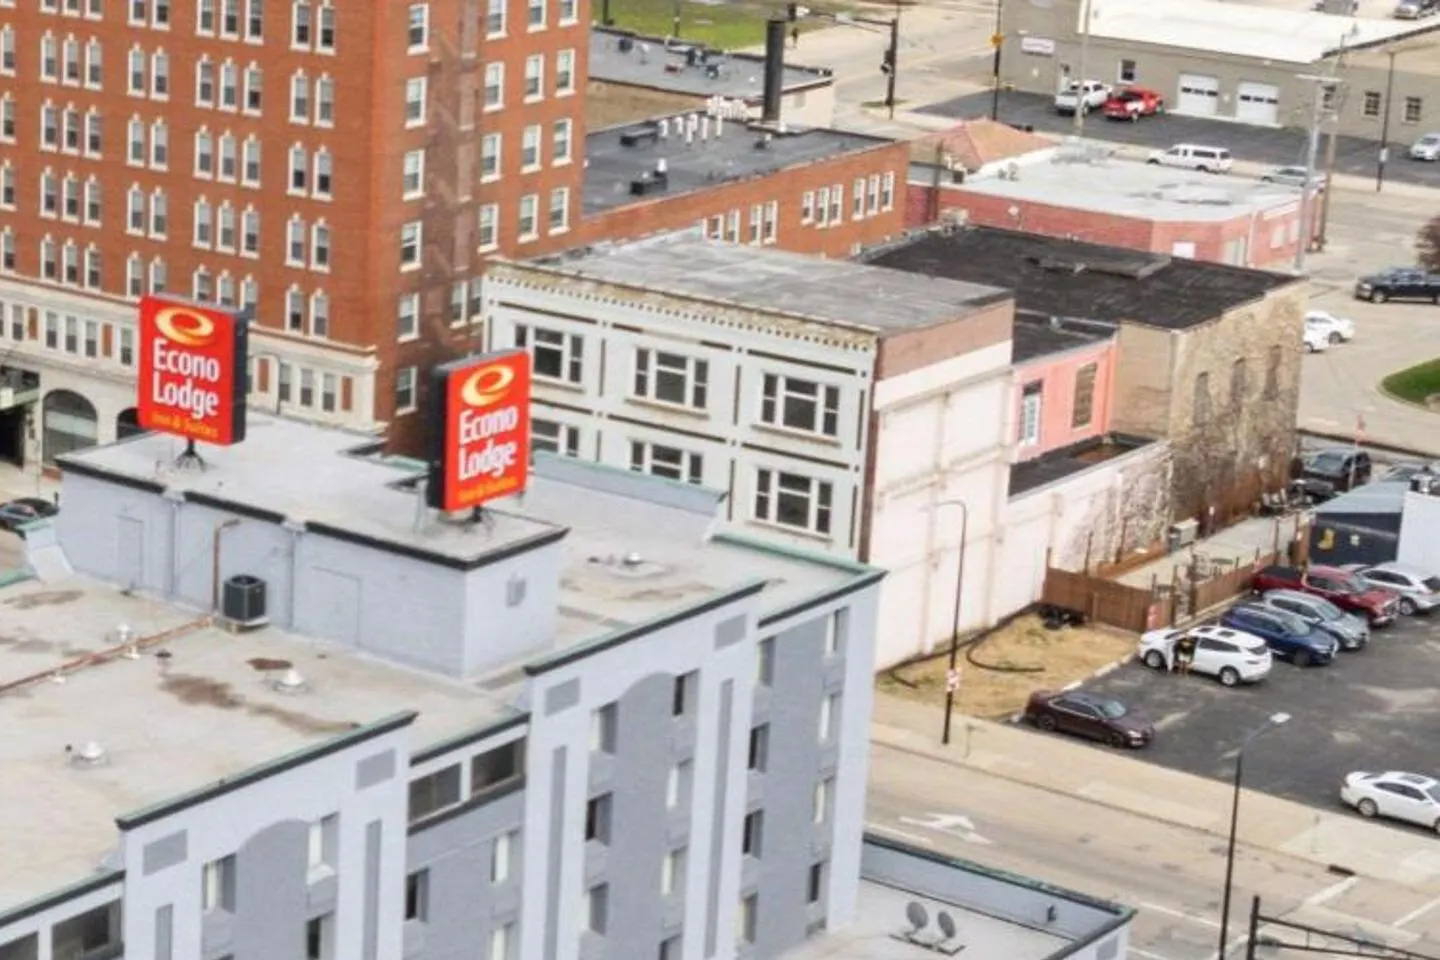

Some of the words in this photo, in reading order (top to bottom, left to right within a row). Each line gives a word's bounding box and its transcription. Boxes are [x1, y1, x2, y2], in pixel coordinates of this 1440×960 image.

[153, 337, 220, 382] Econo
[153, 371, 220, 420] Lodge
[459, 406, 518, 445] Econo
[459, 438, 517, 480] Lodge
